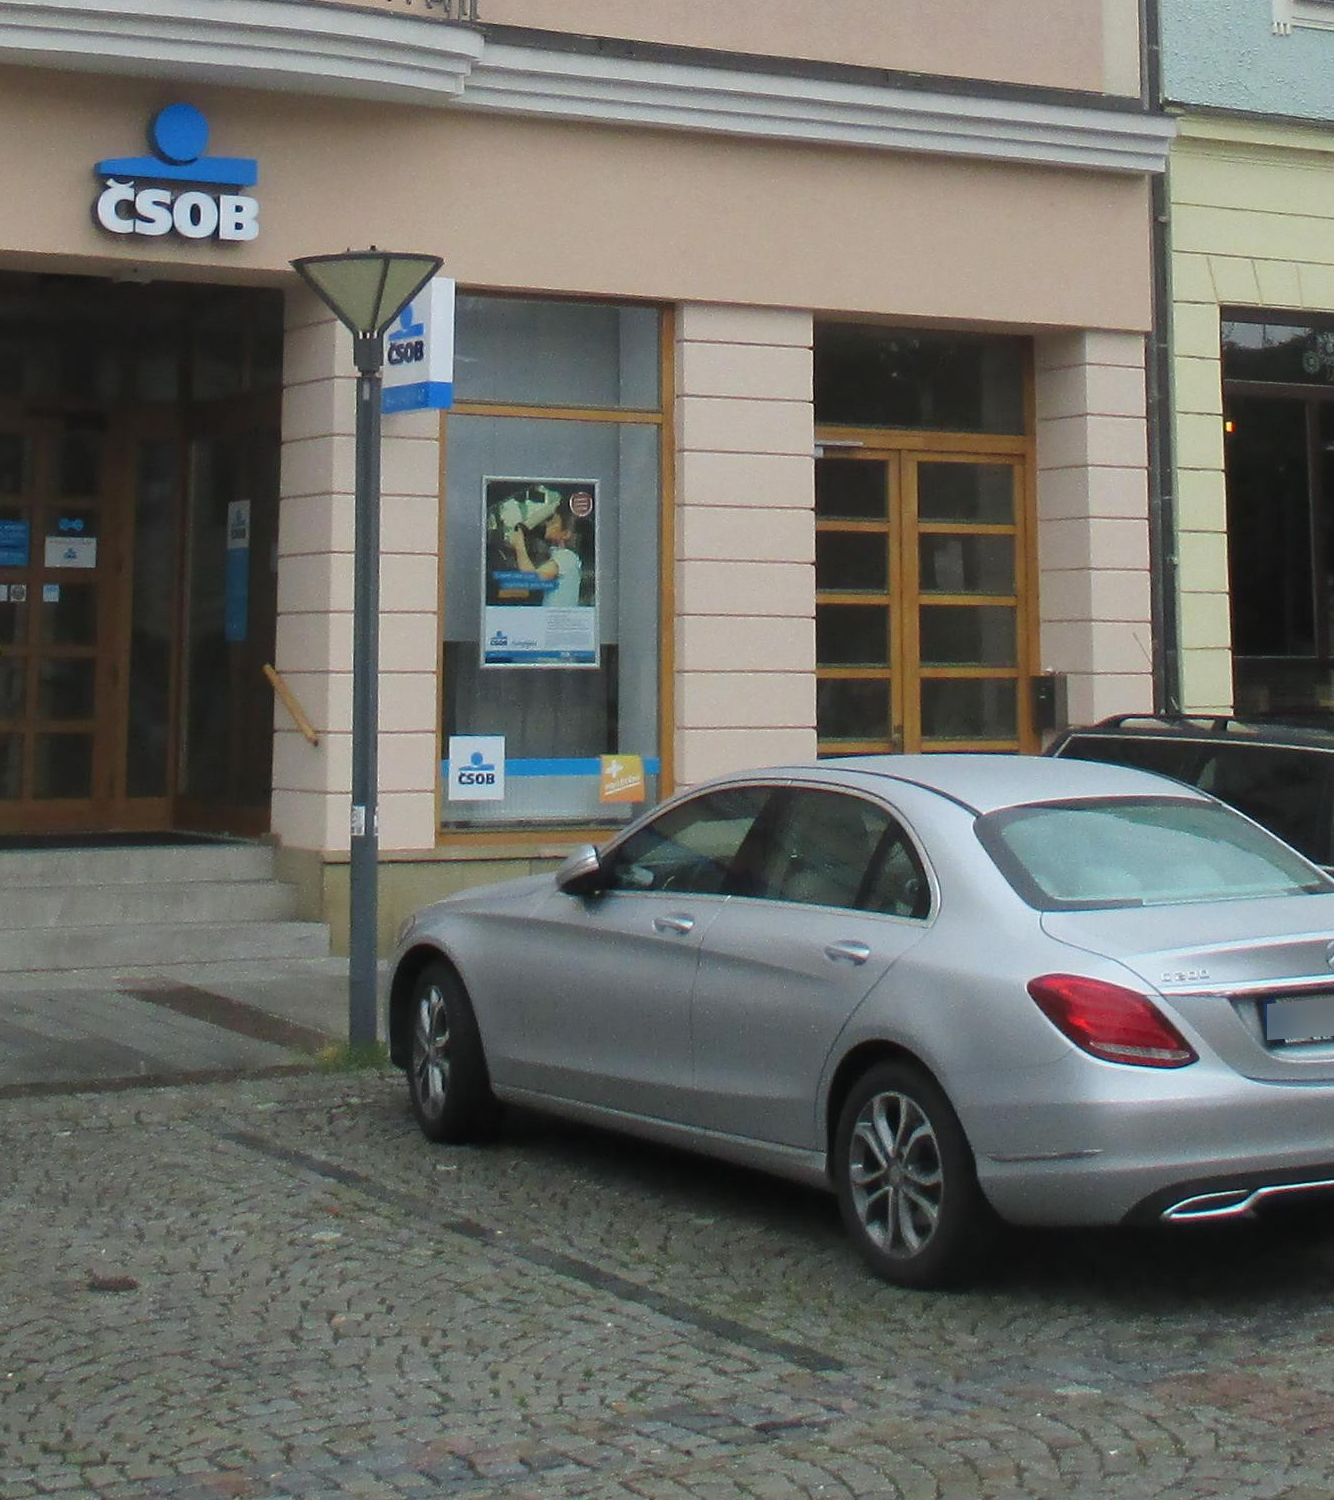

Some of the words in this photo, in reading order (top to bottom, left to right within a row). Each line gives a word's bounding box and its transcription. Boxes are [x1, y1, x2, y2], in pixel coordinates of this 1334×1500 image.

[97, 178, 260, 241] ČSOB
[387, 340, 424, 365] ČSOB
[458, 770, 496, 786] ČSOB
